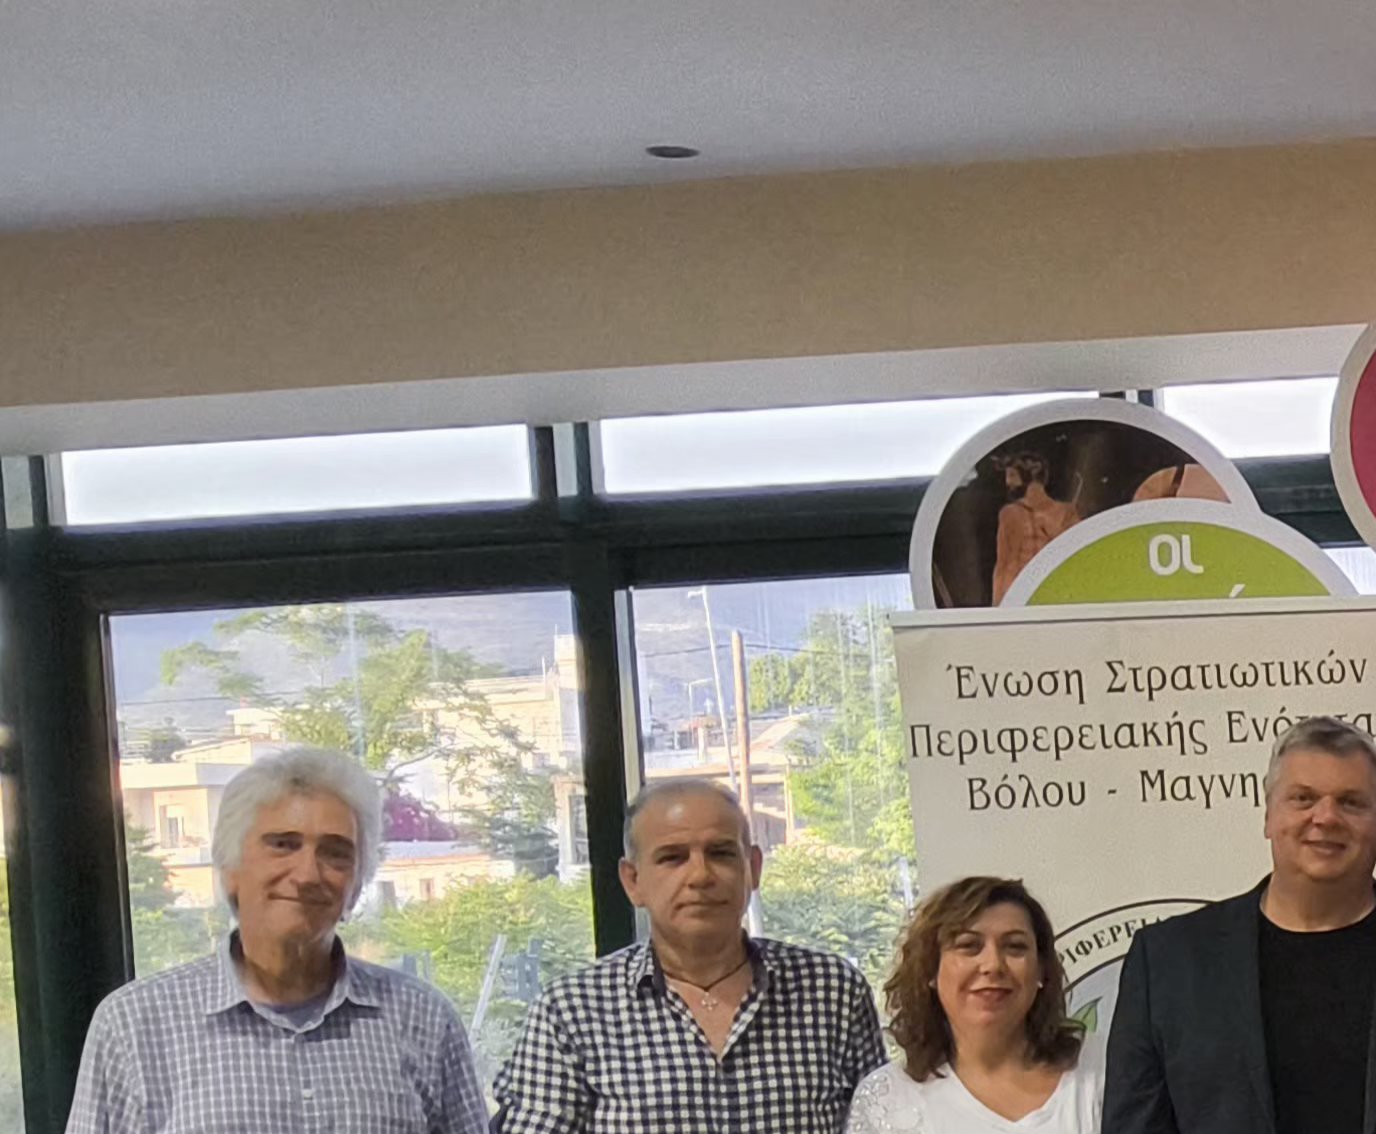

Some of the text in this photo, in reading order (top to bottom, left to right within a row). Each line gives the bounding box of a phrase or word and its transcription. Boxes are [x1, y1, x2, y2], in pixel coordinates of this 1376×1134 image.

[946, 649, 1367, 705] Ένωση Στρατιωτικών
[910, 710, 1208, 766] Περιφερειακής
[967, 773, 1086, 811] Βόλου
[1139, 768, 1264, 810] Μαγνη
